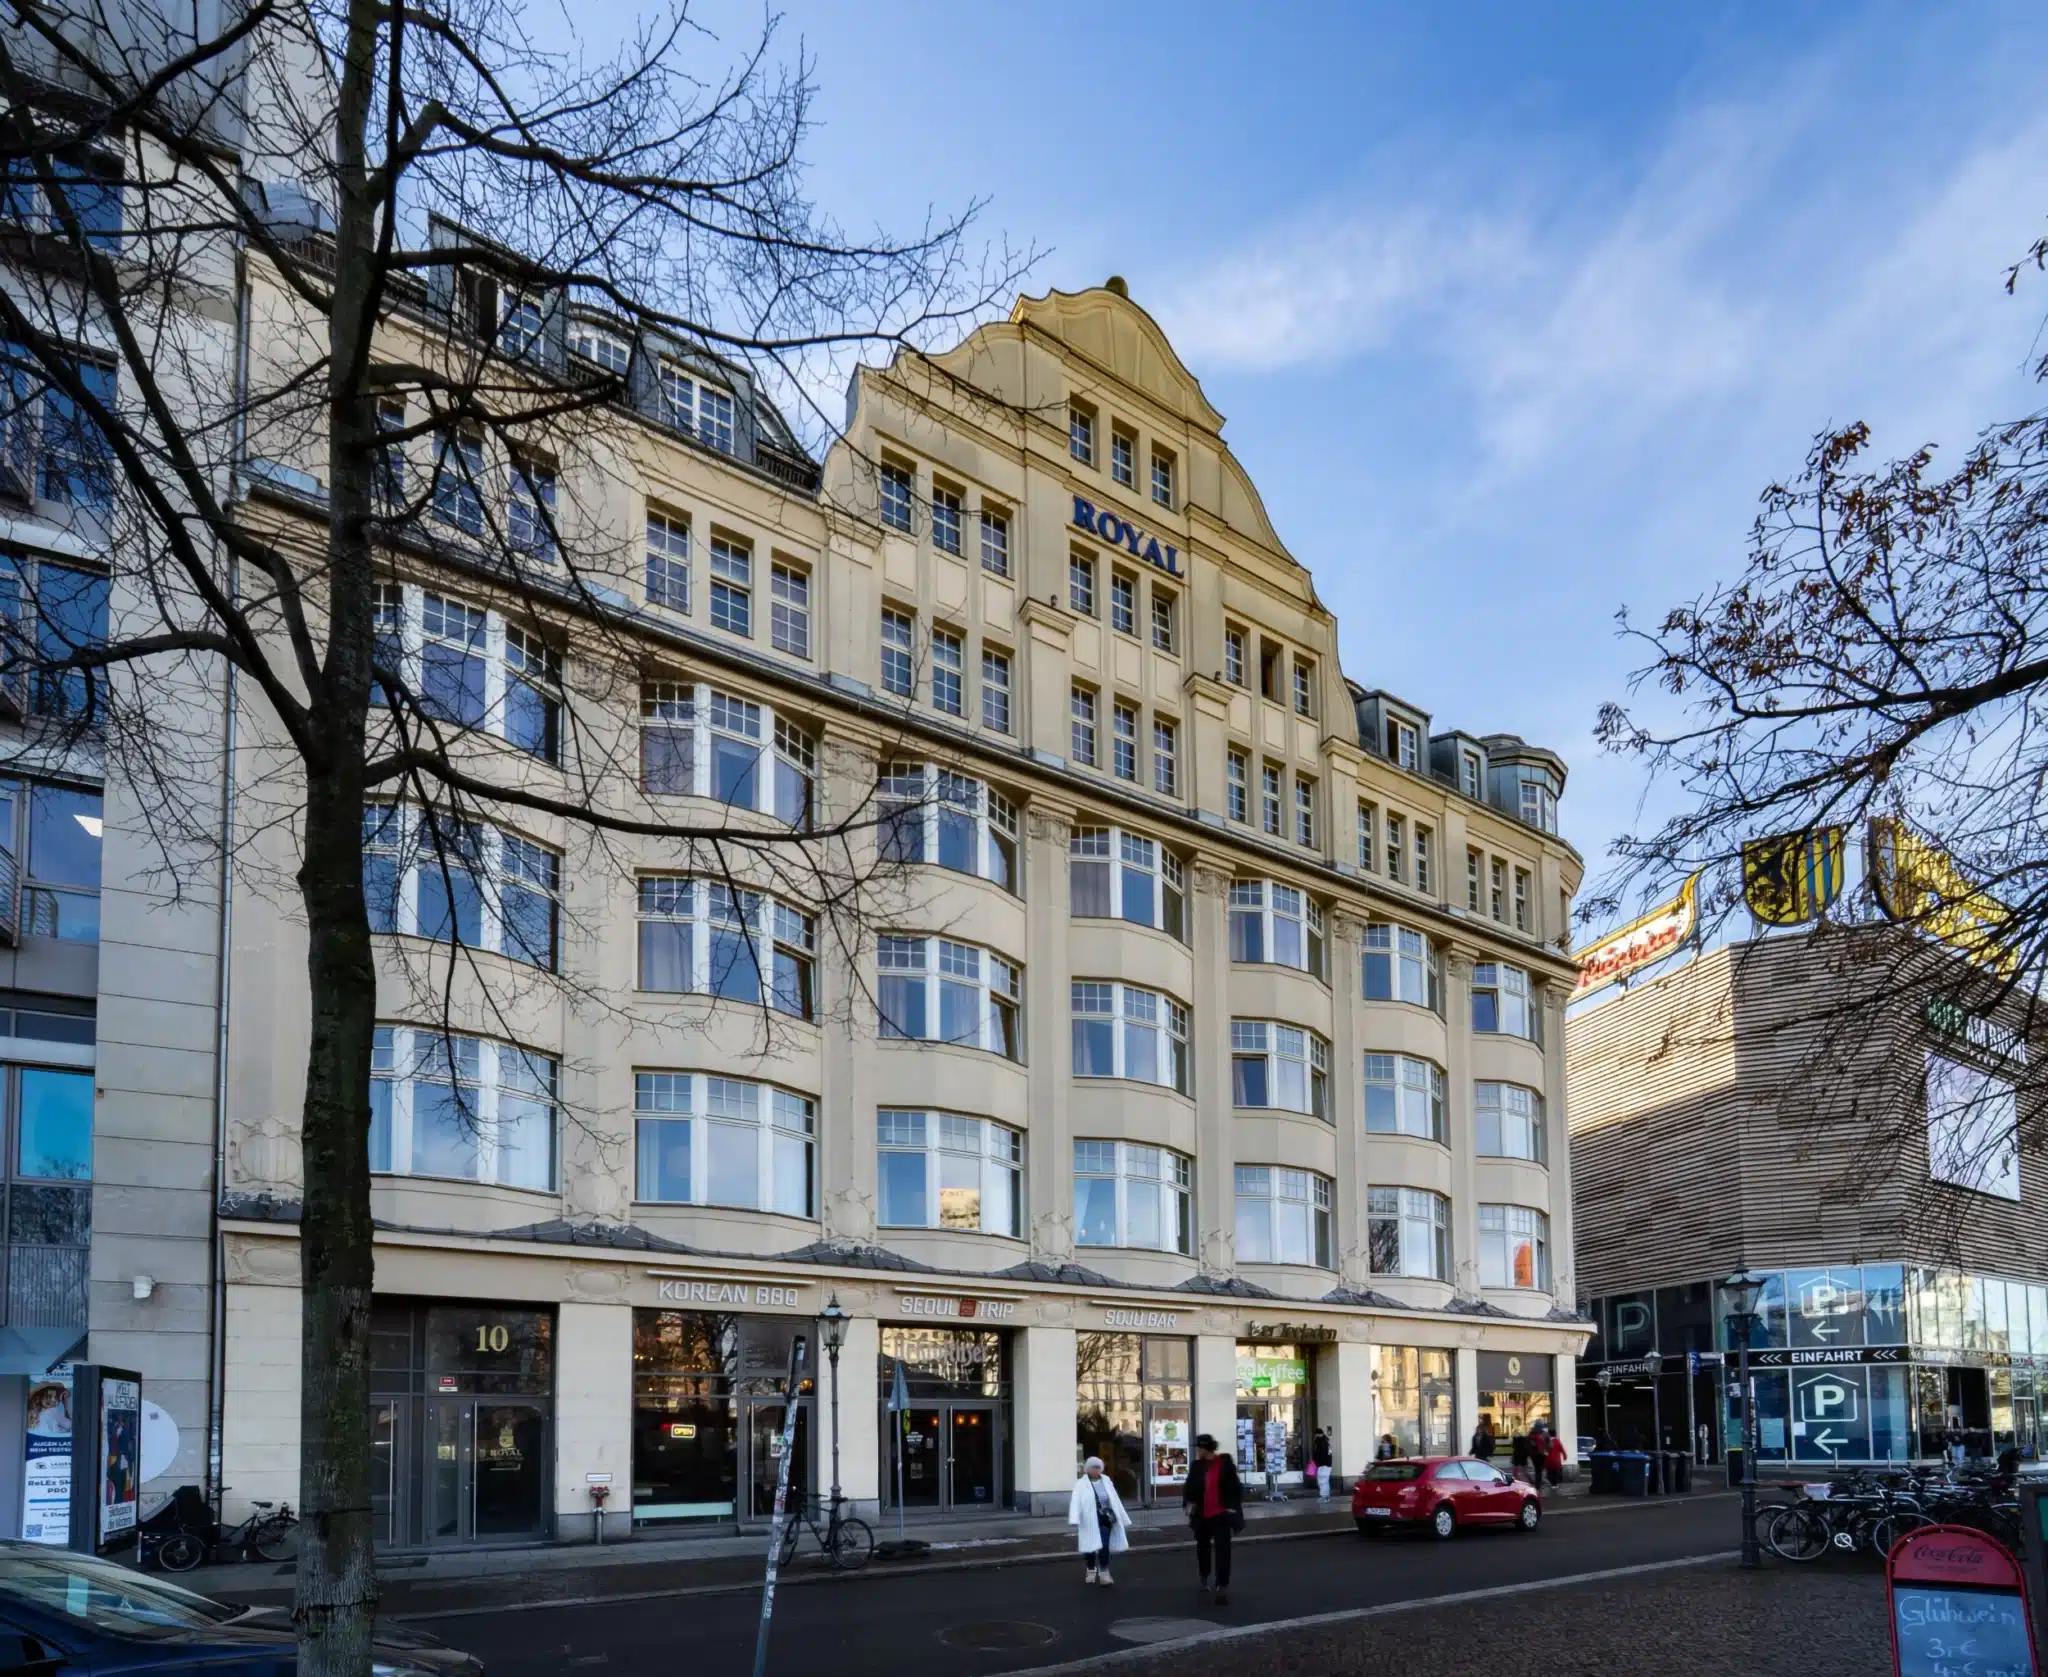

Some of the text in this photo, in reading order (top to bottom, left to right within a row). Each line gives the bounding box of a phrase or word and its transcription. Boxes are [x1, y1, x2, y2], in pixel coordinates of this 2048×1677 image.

[1073, 495, 1184, 579] ROYAL
[660, 1280, 797, 1307] KOREAN BBQ
[1812, 1286, 1837, 1311] P
[901, 1297, 1014, 1318] SEOUL TRIP
[1105, 1309, 1177, 1328] SOJU BAR
[476, 1325, 508, 1351] 10
[1617, 1302, 1651, 1352] P
[1606, 1362, 1654, 1375] EINFAHRT
[1791, 1350, 1864, 1363] EINFAHRT
[1236, 1362, 1305, 1380] ee Kaffee
[1814, 1385, 1845, 1416] P
[490, 1449, 522, 1457] ROYAL
[1900, 1595, 2016, 1636] Glühwein
